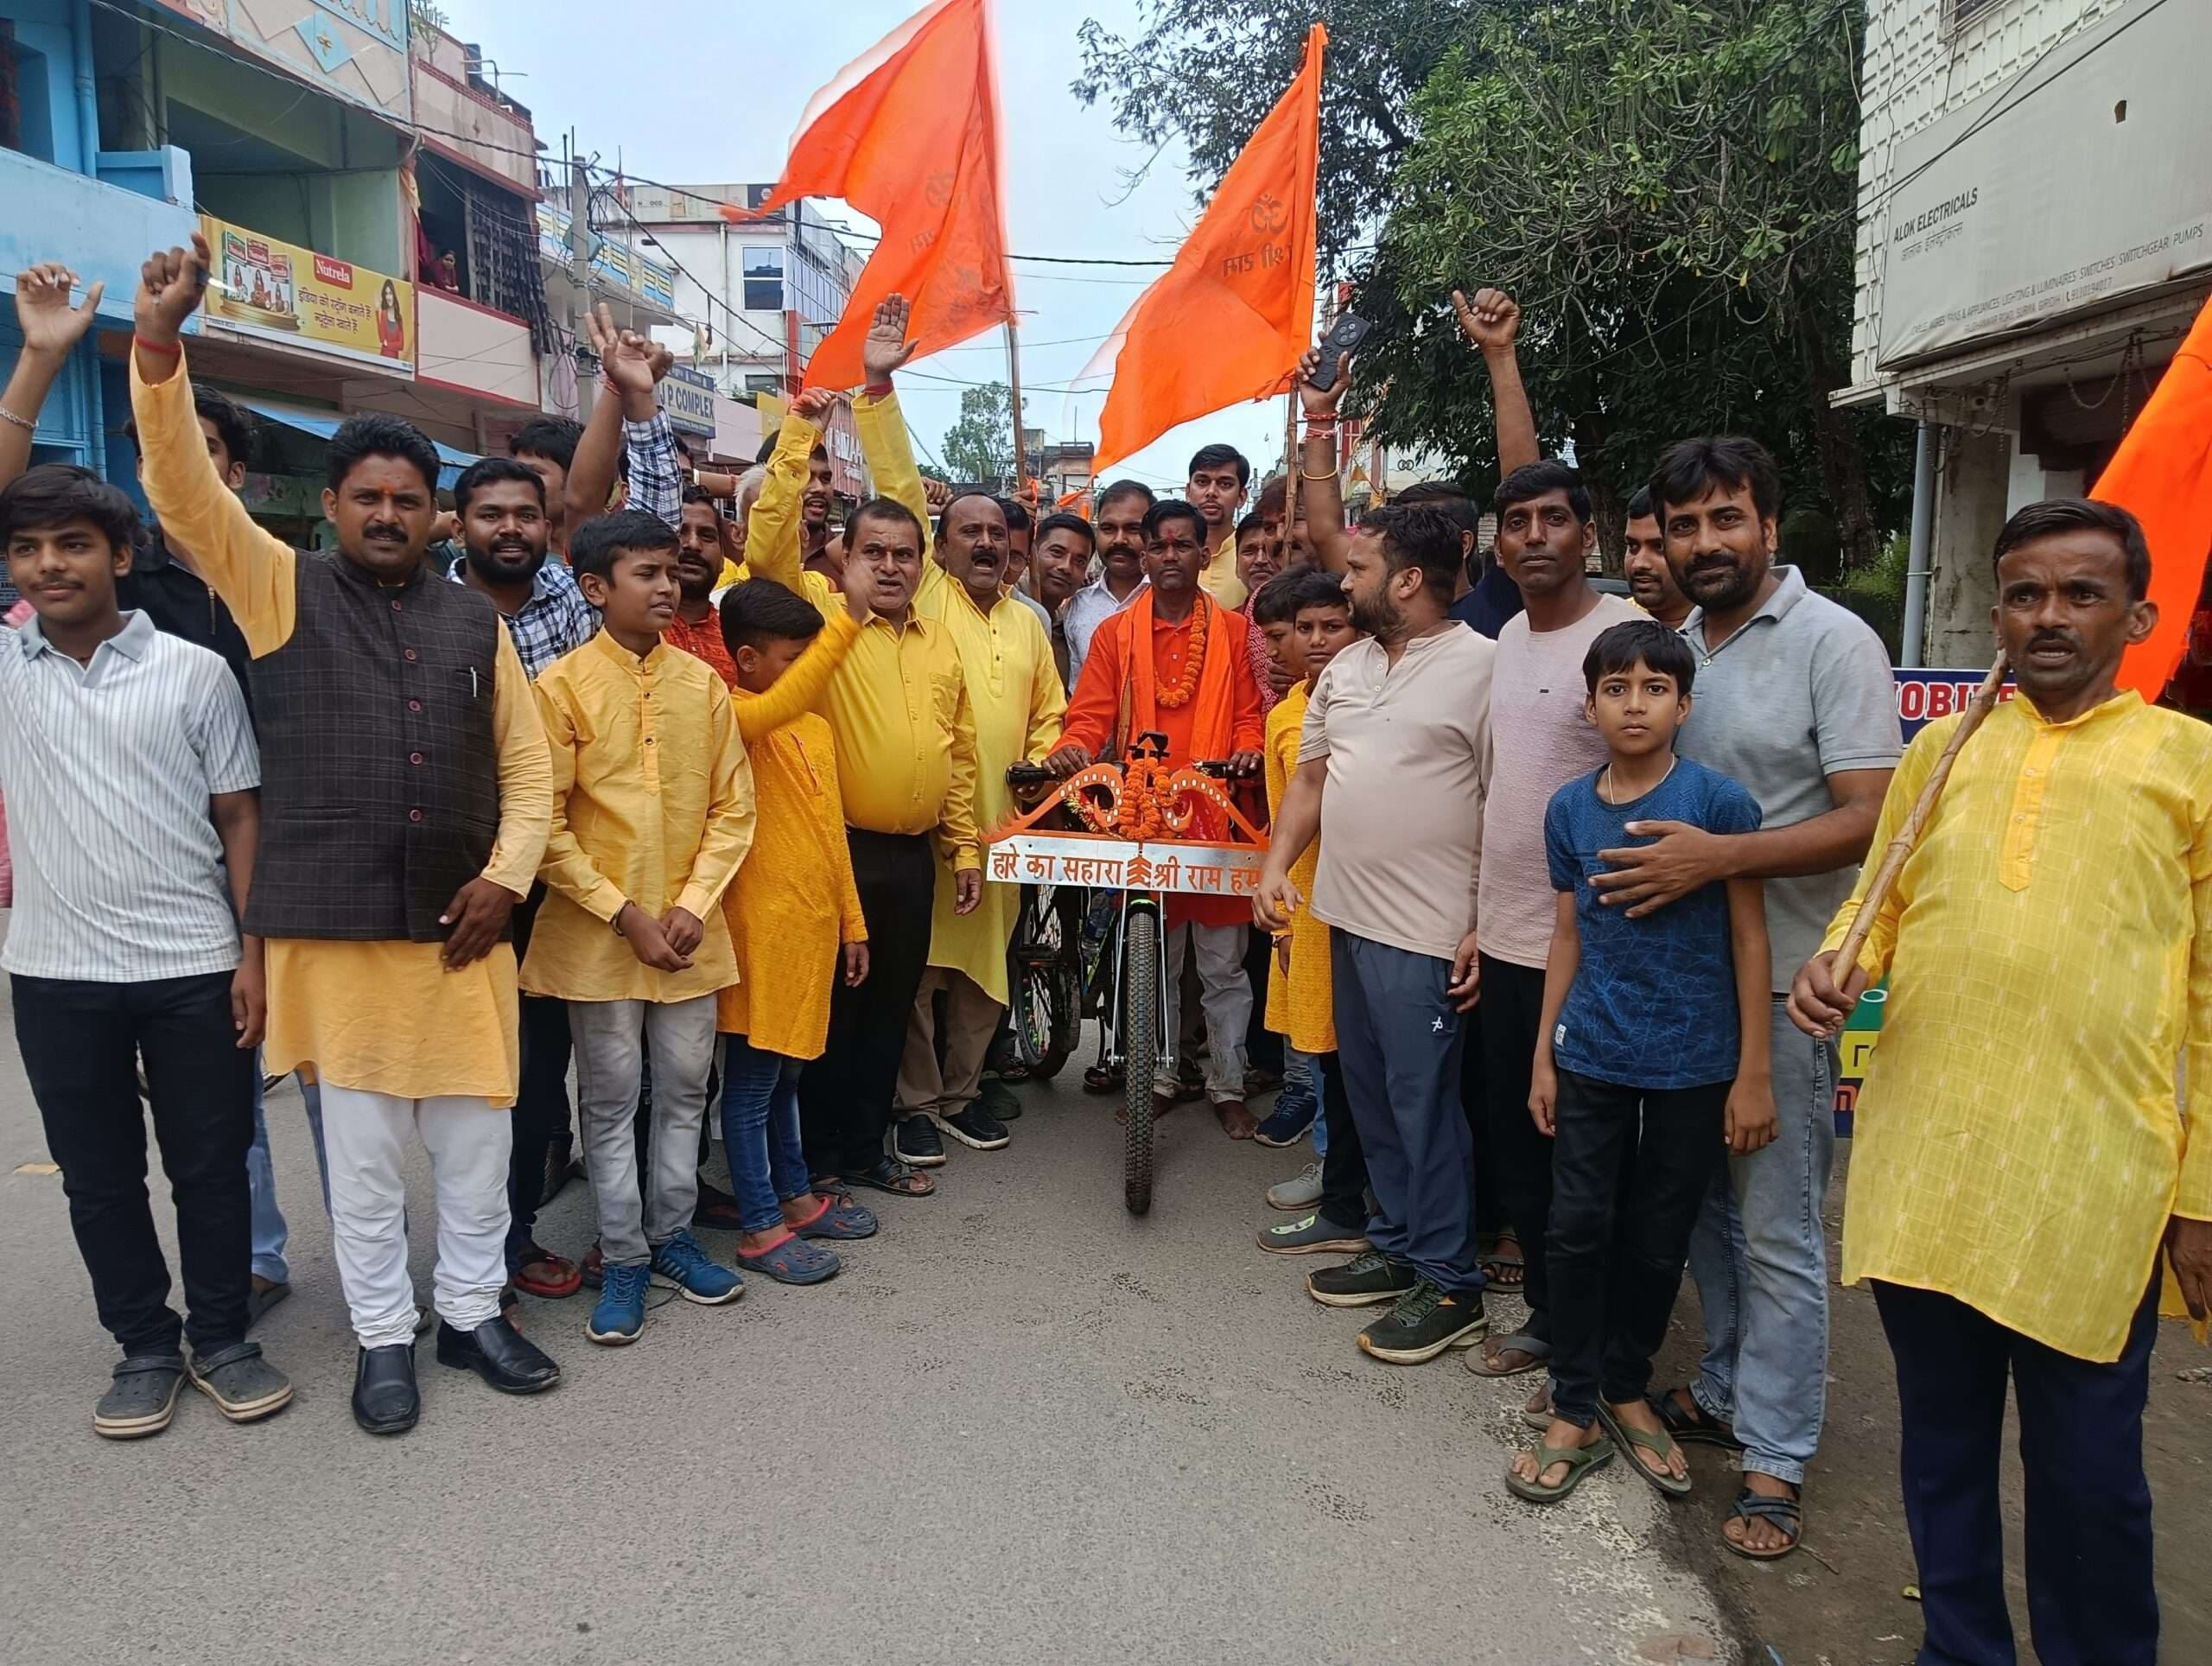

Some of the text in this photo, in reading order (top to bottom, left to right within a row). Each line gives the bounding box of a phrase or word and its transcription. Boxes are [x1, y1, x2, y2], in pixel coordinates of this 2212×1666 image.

[1893, 187, 1978, 244] ALOK ELECTRICALS
[316, 260, 350, 283] Nutrela
[2079, 256, 2115, 280] SWITCHES
[2117, 237, 2170, 265] SWITCHGEAR
[2172, 223, 2204, 246] PUMPS
[667, 384, 674, 408] P
[676, 386, 715, 421] COMPLEX
[1025, 853, 1057, 881] का
[1061, 855, 1124, 888] सहारा
[1154, 855, 1181, 888] श्री
[1185, 864, 1224, 893] राम
